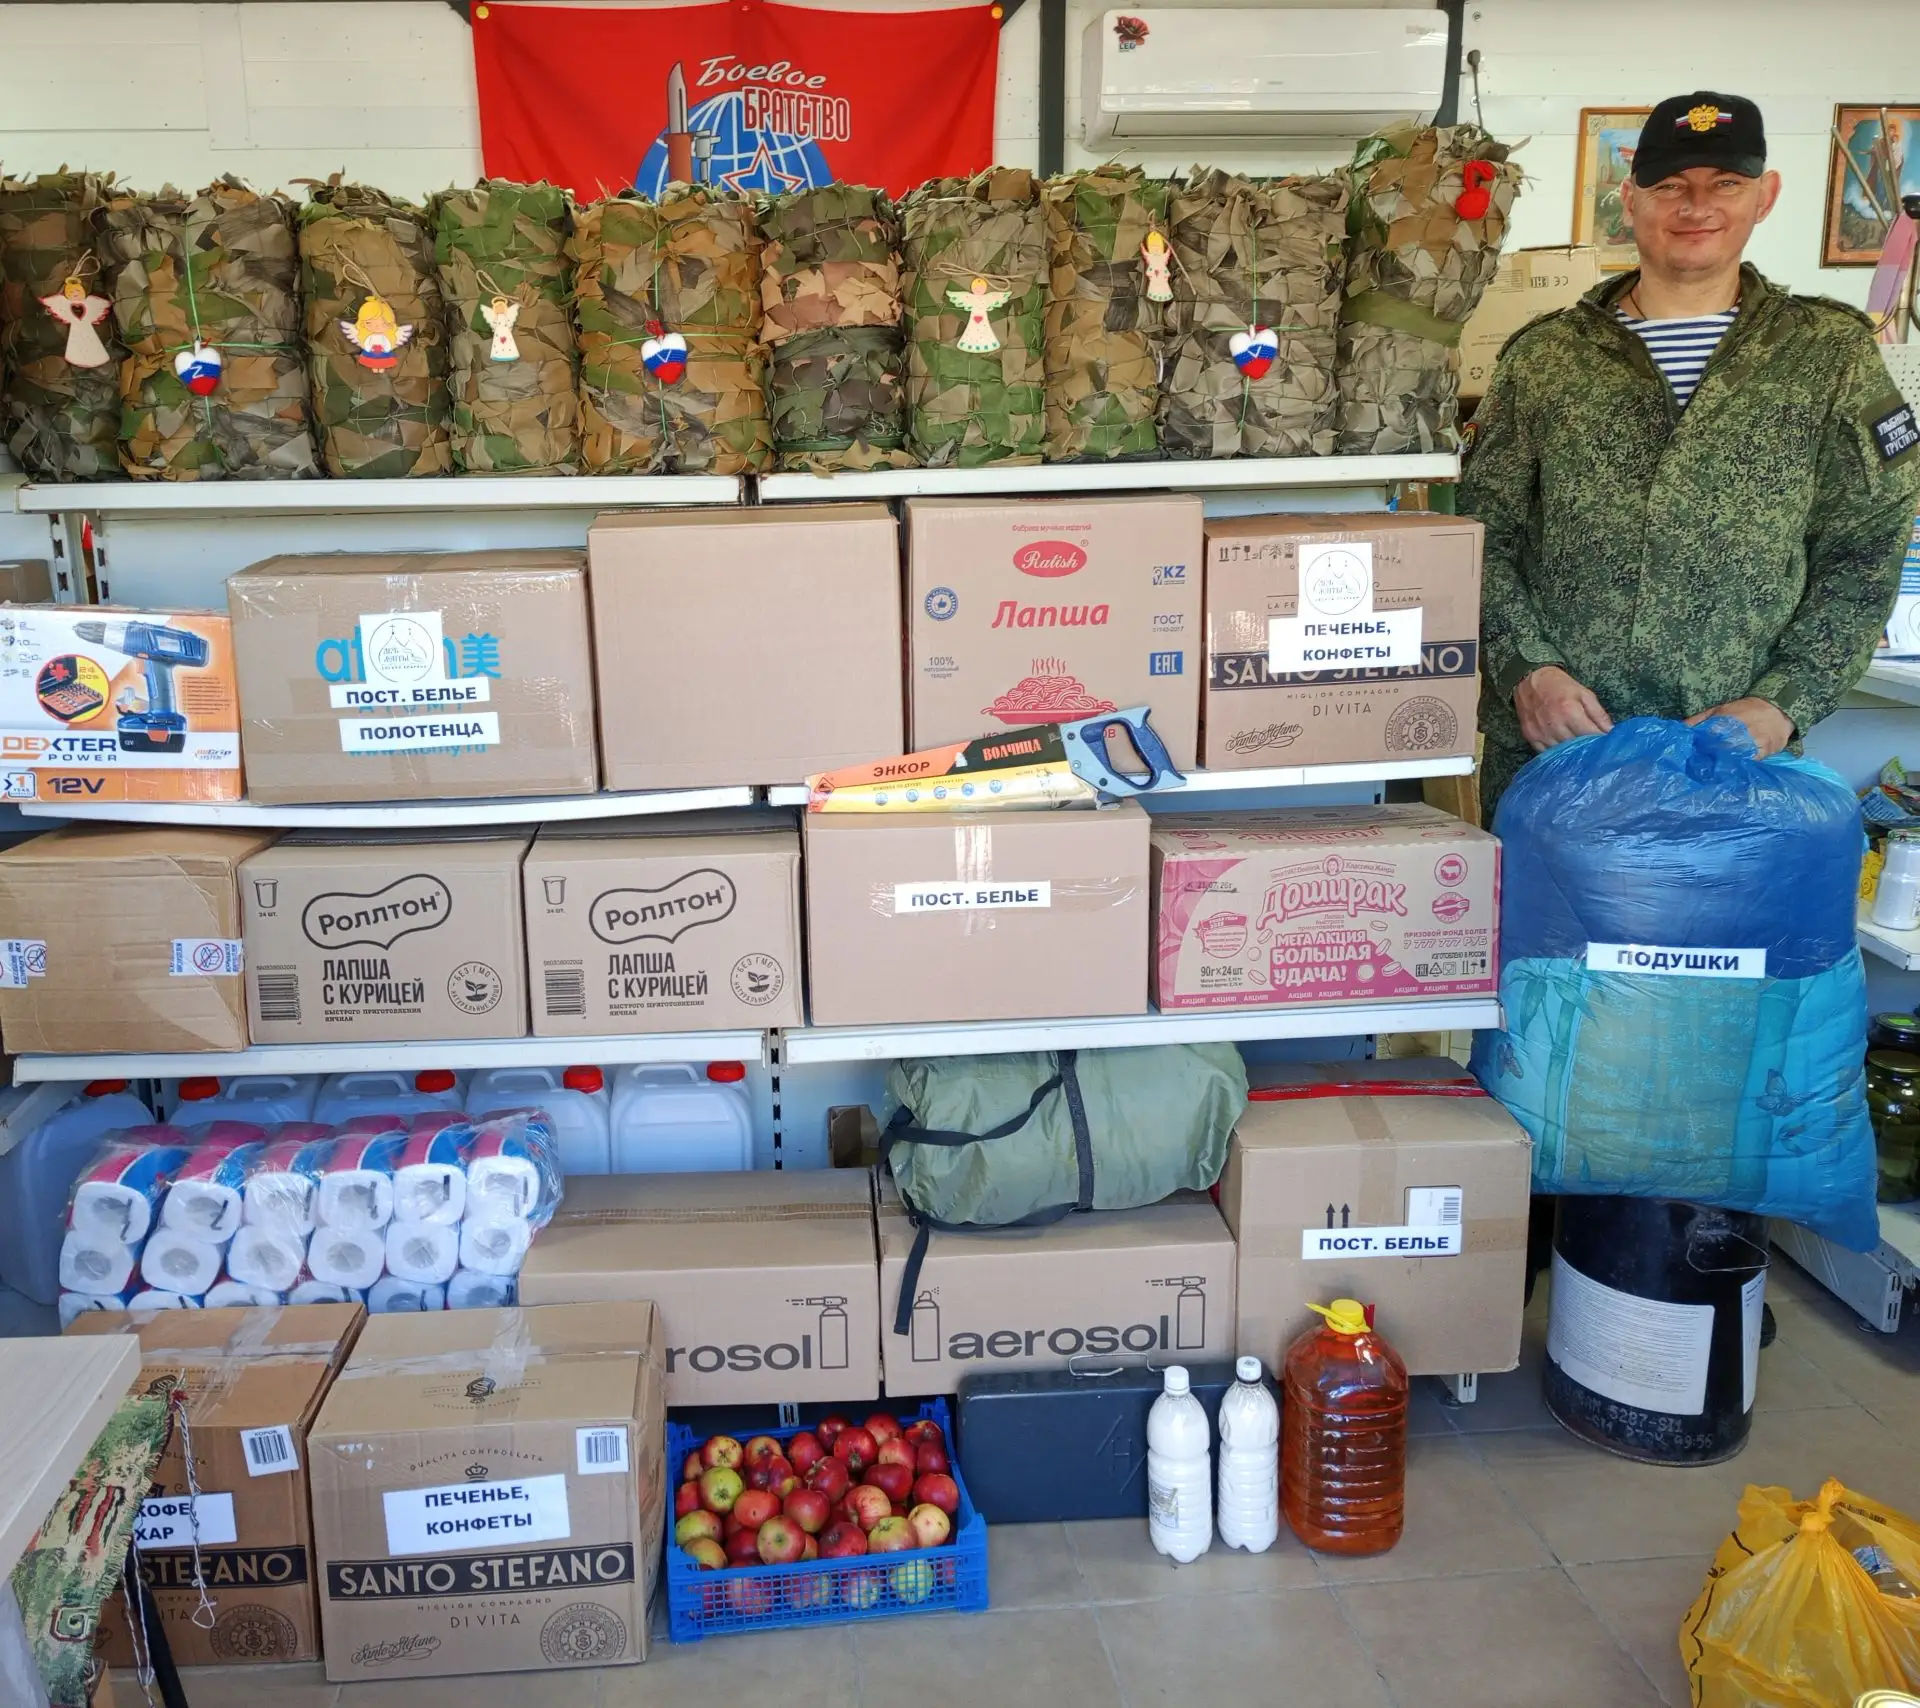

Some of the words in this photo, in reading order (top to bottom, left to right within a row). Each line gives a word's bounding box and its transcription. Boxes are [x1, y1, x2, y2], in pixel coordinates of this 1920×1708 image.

[696, 54, 827, 90] Боевое
[743, 86, 851, 142] БРАТСТВО
[1885, 430, 1918, 456] ГРУСТИТЬ
[1163, 565, 1186, 579] KZ
[991, 601, 1110, 629] Лапша
[1153, 614, 1184, 625] ГОСТ
[1304, 621, 1392, 637] ПЕЧЕНЬЕ,
[928, 656, 955, 666] 100%
[1303, 646, 1391, 661] КОНФЕТЫ
[346, 689, 407, 705] ПОСТ.
[411, 686, 478, 702] БЕЛЬЕ
[1313, 704, 1329, 717] DI
[1335, 702, 1373, 715] VITA
[359, 722, 484, 741] ПОЛОТЕНЦА
[3, 736, 117, 752] DEXTER
[982, 738, 1042, 761] ВОЛЧИЦА
[873, 761, 931, 777] ЭНКОР
[47, 777, 105, 794] 12V
[911, 890, 969, 907] ПОСТ.
[976, 888, 1039, 904] БЕЛЬЕ
[1256, 878, 1408, 931] Доширак
[1276, 932, 1312, 946] МЕГА
[1316, 930, 1367, 943] АКЦИЯ
[1404, 929, 1441, 938] ПРИЗОВОЙ
[1442, 929, 1463, 937] ФОНД
[1465, 928, 1488, 936] БОЛЕЕ
[608, 952, 676, 975] ЛАПША
[737, 958, 752, 974] БЕЗ
[755, 956, 773, 968] ГМО
[1272, 944, 1371, 965] БОЛЬШАЯ
[1617, 949, 1739, 971] ПОДУШКИ
[323, 958, 391, 981] ЛАПША
[454, 967, 470, 981] БЕЗ
[473, 965, 491, 977] ГМО
[1272, 965, 1348, 988] УДАЧА!
[323, 984, 335, 1005] С
[340, 977, 425, 1006] КУРИЦЕЙ
[608, 978, 619, 999] С
[624, 970, 708, 999] КУРИЦЕЙ
[734, 981, 771, 1004] НАТУРАЛЬНЫЕ
[450, 990, 489, 1013] НАТУРАЛЬНЫЕ
[646, 1000, 705, 1008] ПРИГОТОВЛЕНИЯ
[1319, 1237, 1378, 1250] ПОСТ.
[1385, 1236, 1449, 1250] БЕЛЬЕ
[948, 1315, 1169, 1359] aerosol
[666, 1334, 812, 1374] rosol
[424, 1485, 529, 1508] ПЕЧЕНЬЕ,
[426, 1512, 532, 1535] КОНФЕТЫ
[340, 1563, 456, 1596] SANTO
[470, 1550, 625, 1590] STEFANO
[450, 1616, 469, 1629] DI
[476, 1613, 521, 1626] VITA
